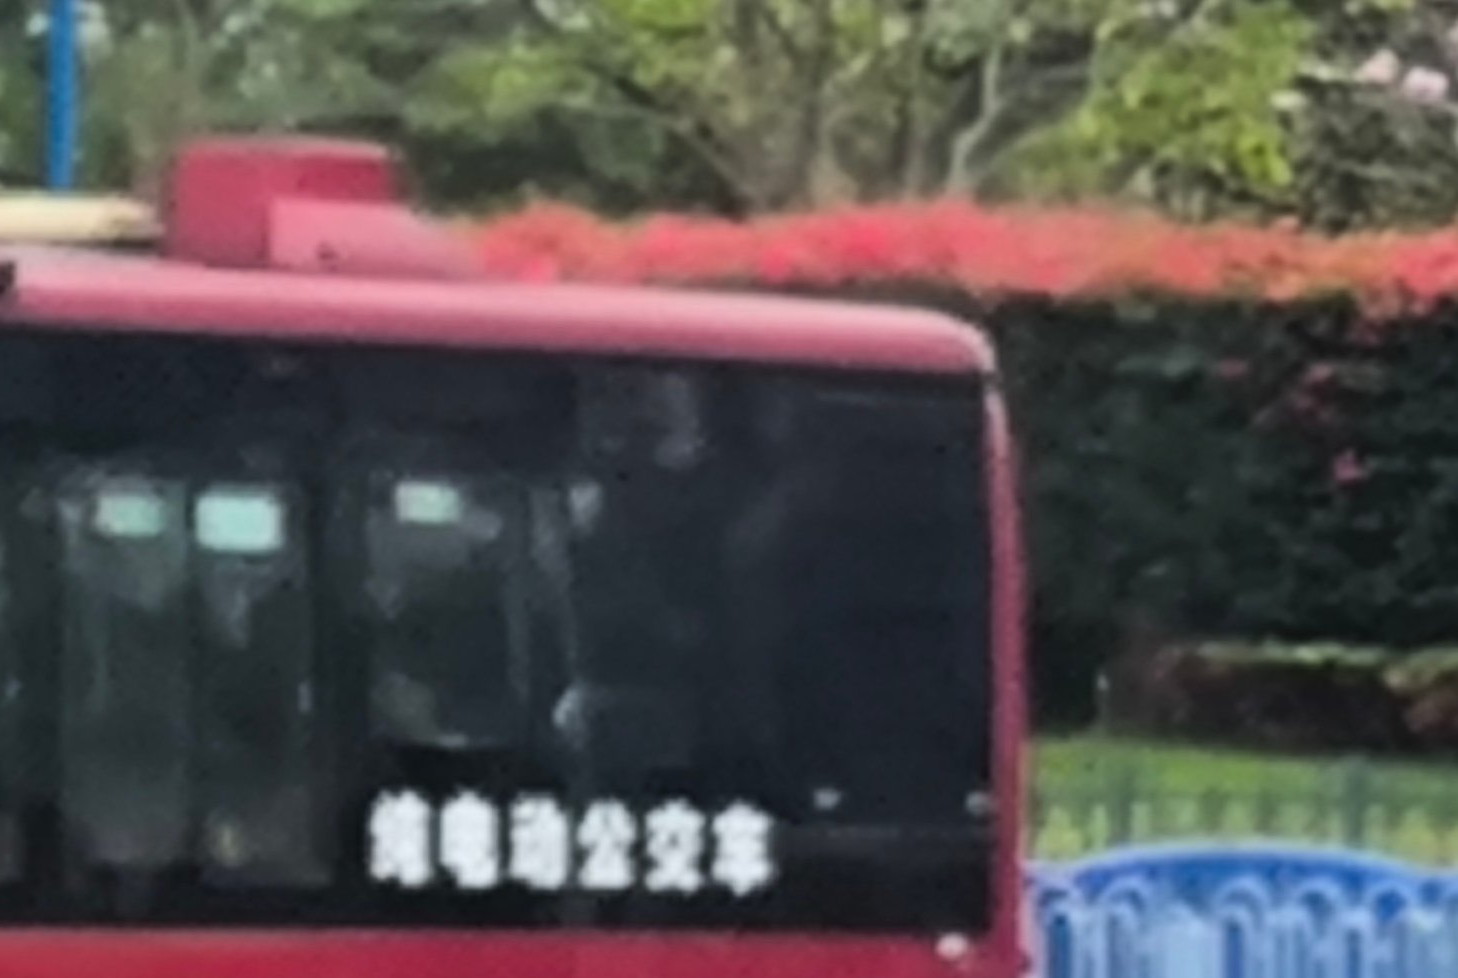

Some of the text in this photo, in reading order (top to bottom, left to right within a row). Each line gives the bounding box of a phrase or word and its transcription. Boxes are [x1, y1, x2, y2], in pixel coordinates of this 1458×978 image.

[368, 786, 777, 898] 纯电动公交车
